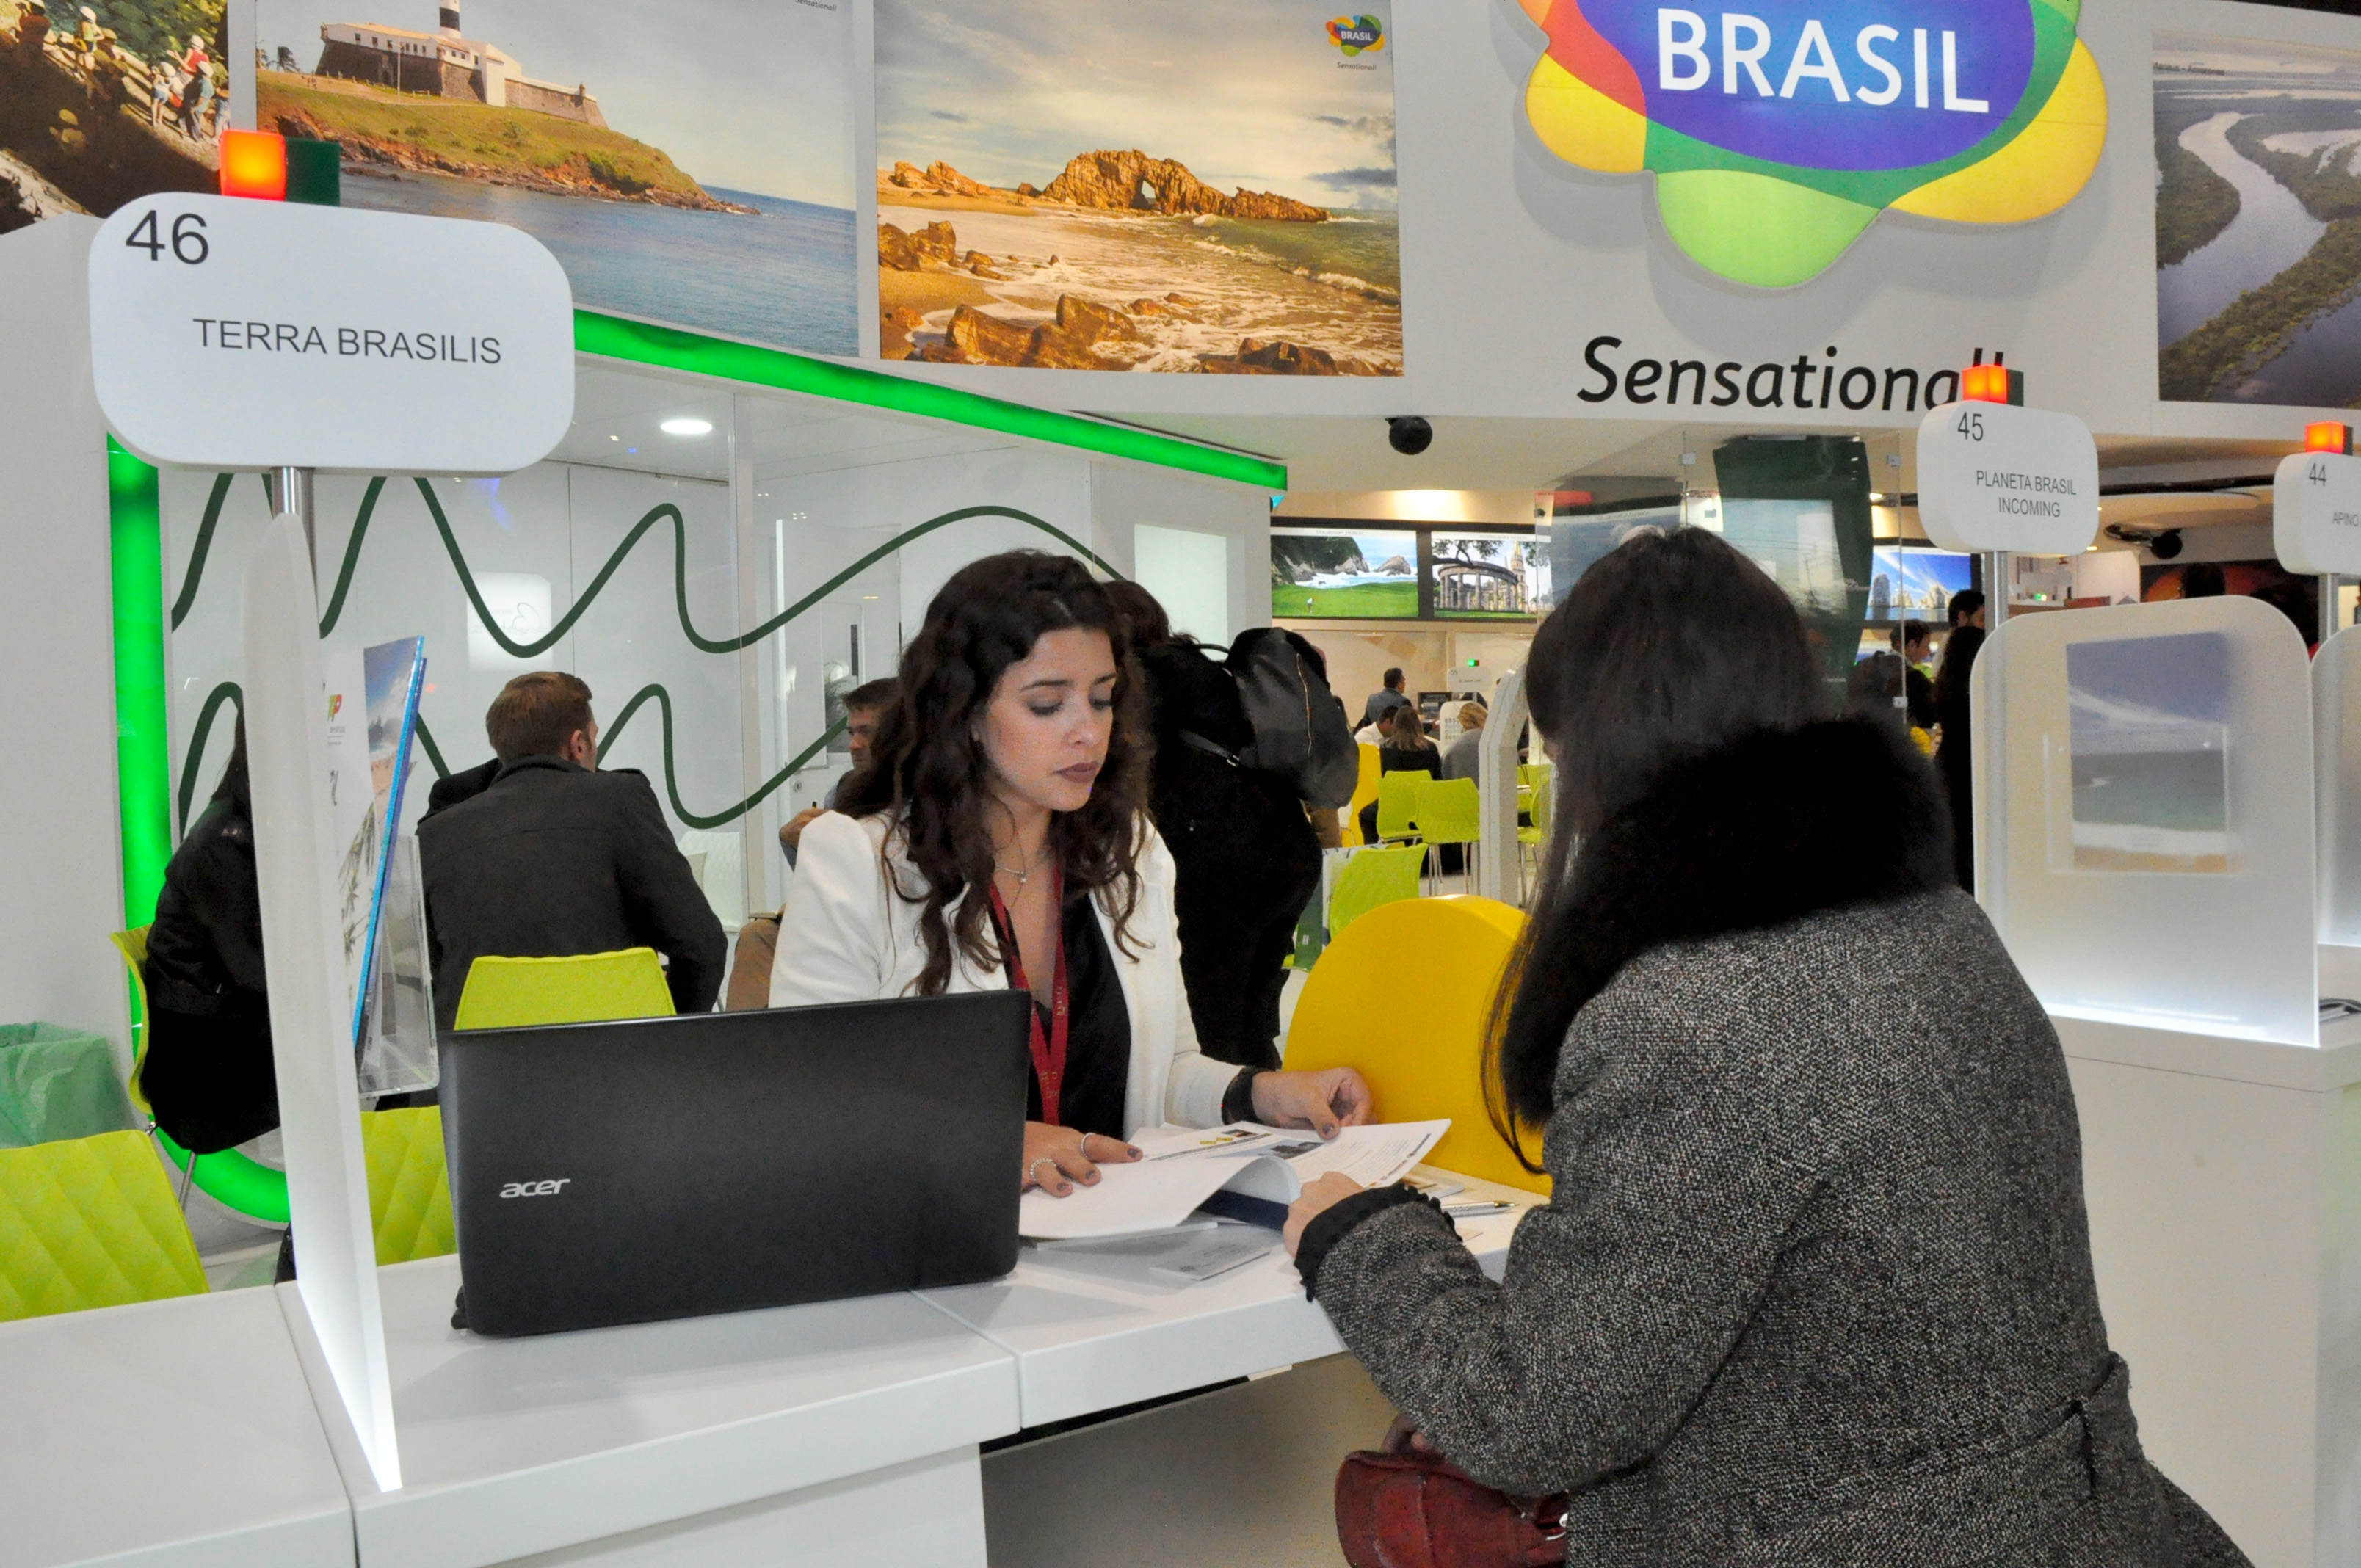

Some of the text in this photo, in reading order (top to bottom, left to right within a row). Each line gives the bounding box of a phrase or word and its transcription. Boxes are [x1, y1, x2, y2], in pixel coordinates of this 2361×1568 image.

[1341, 30, 1373, 41] BRASIL
[1658, 8, 1990, 113] BRASIL
[126, 209, 210, 265] 46
[192, 318, 502, 365] TERRA BRASILIS
[1576, 335, 2003, 412] Sensationa
[1957, 411, 1984, 441] 45
[1976, 470, 2077, 496] PLANETA BRASIL
[2308, 462, 2326, 487] 44
[1998, 497, 2061, 518] INCOMING
[499, 1178, 571, 1198] acer
